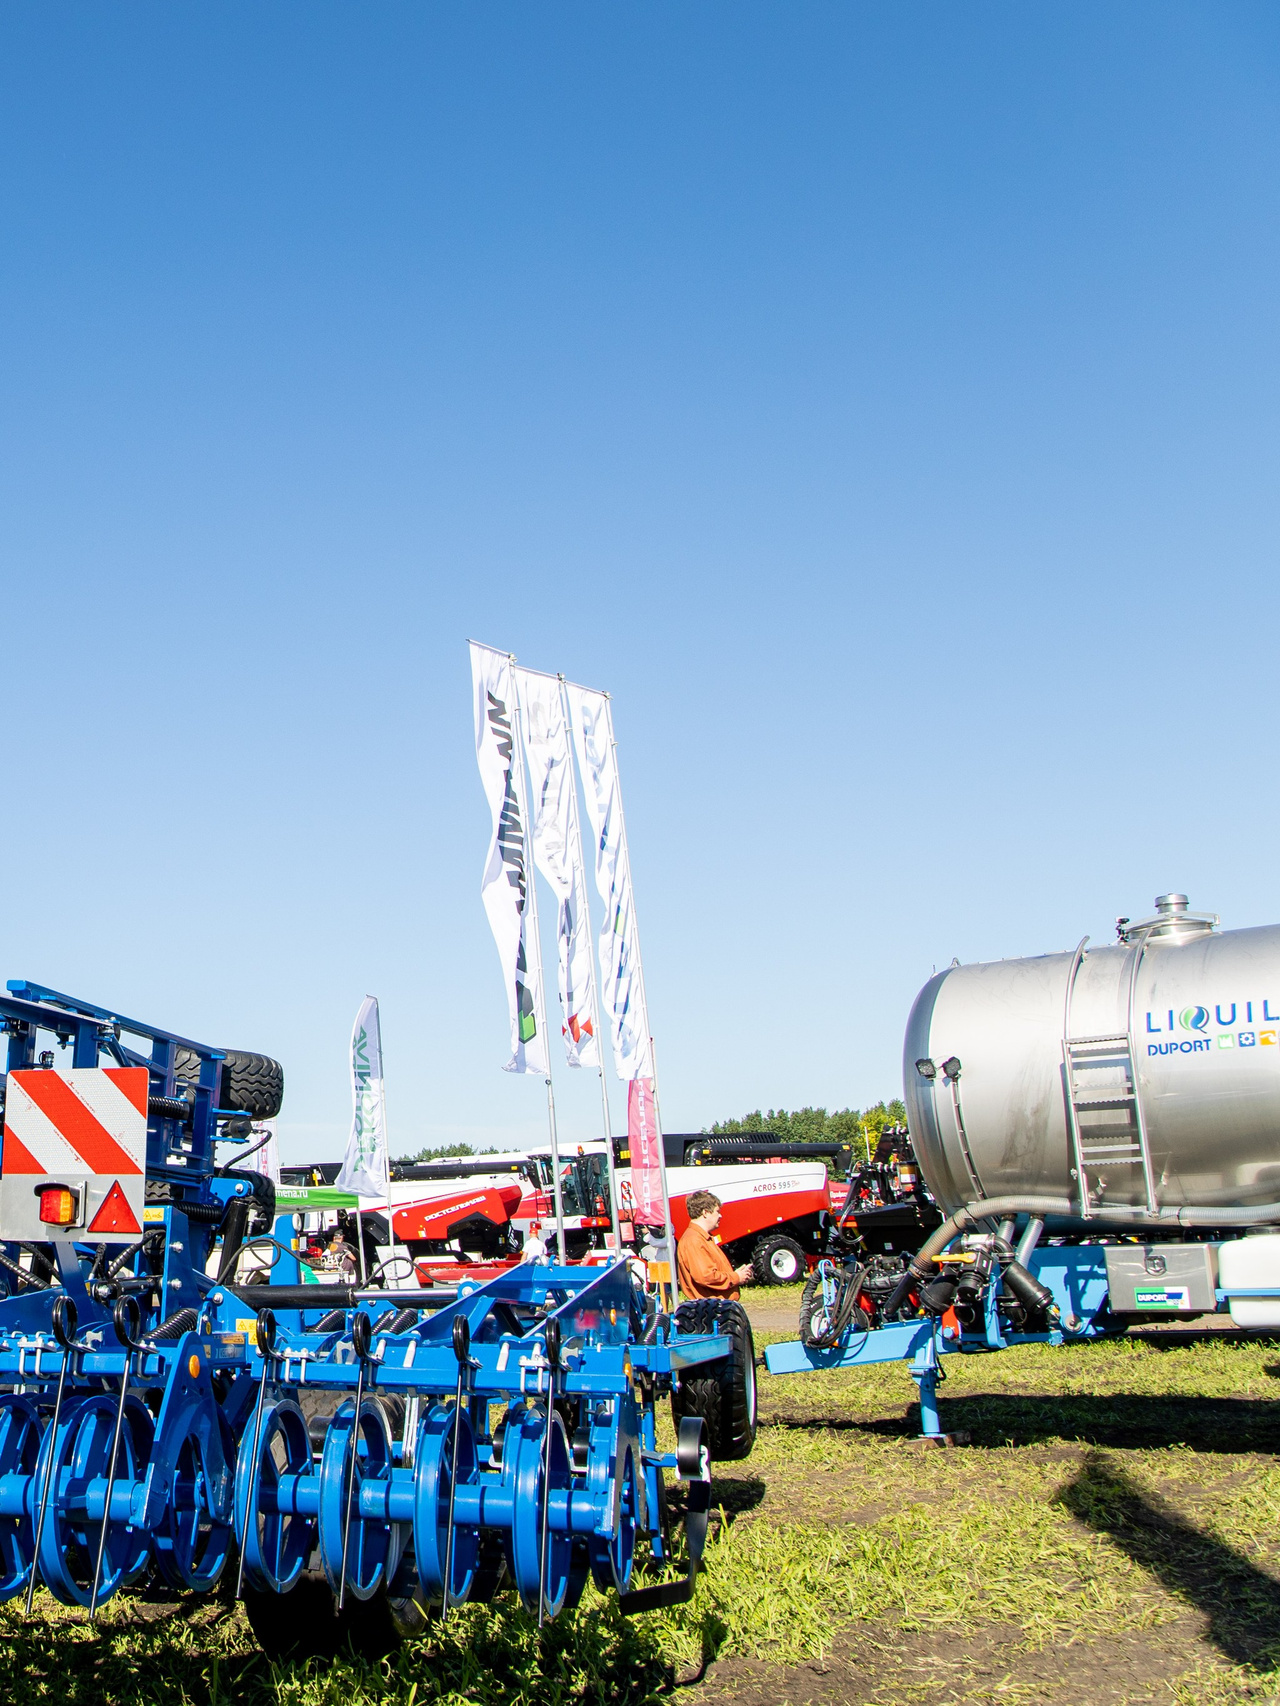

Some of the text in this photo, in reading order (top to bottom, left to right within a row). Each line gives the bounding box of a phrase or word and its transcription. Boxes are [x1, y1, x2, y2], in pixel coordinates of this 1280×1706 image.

[1146, 999, 1280, 1034] LIQUIL
[1147, 1039, 1212, 1056] DUPORT
[752, 1182, 777, 1193] ACROS
[778, 1180, 791, 1189] 595
[1137, 1293, 1169, 1302] DUPORT
